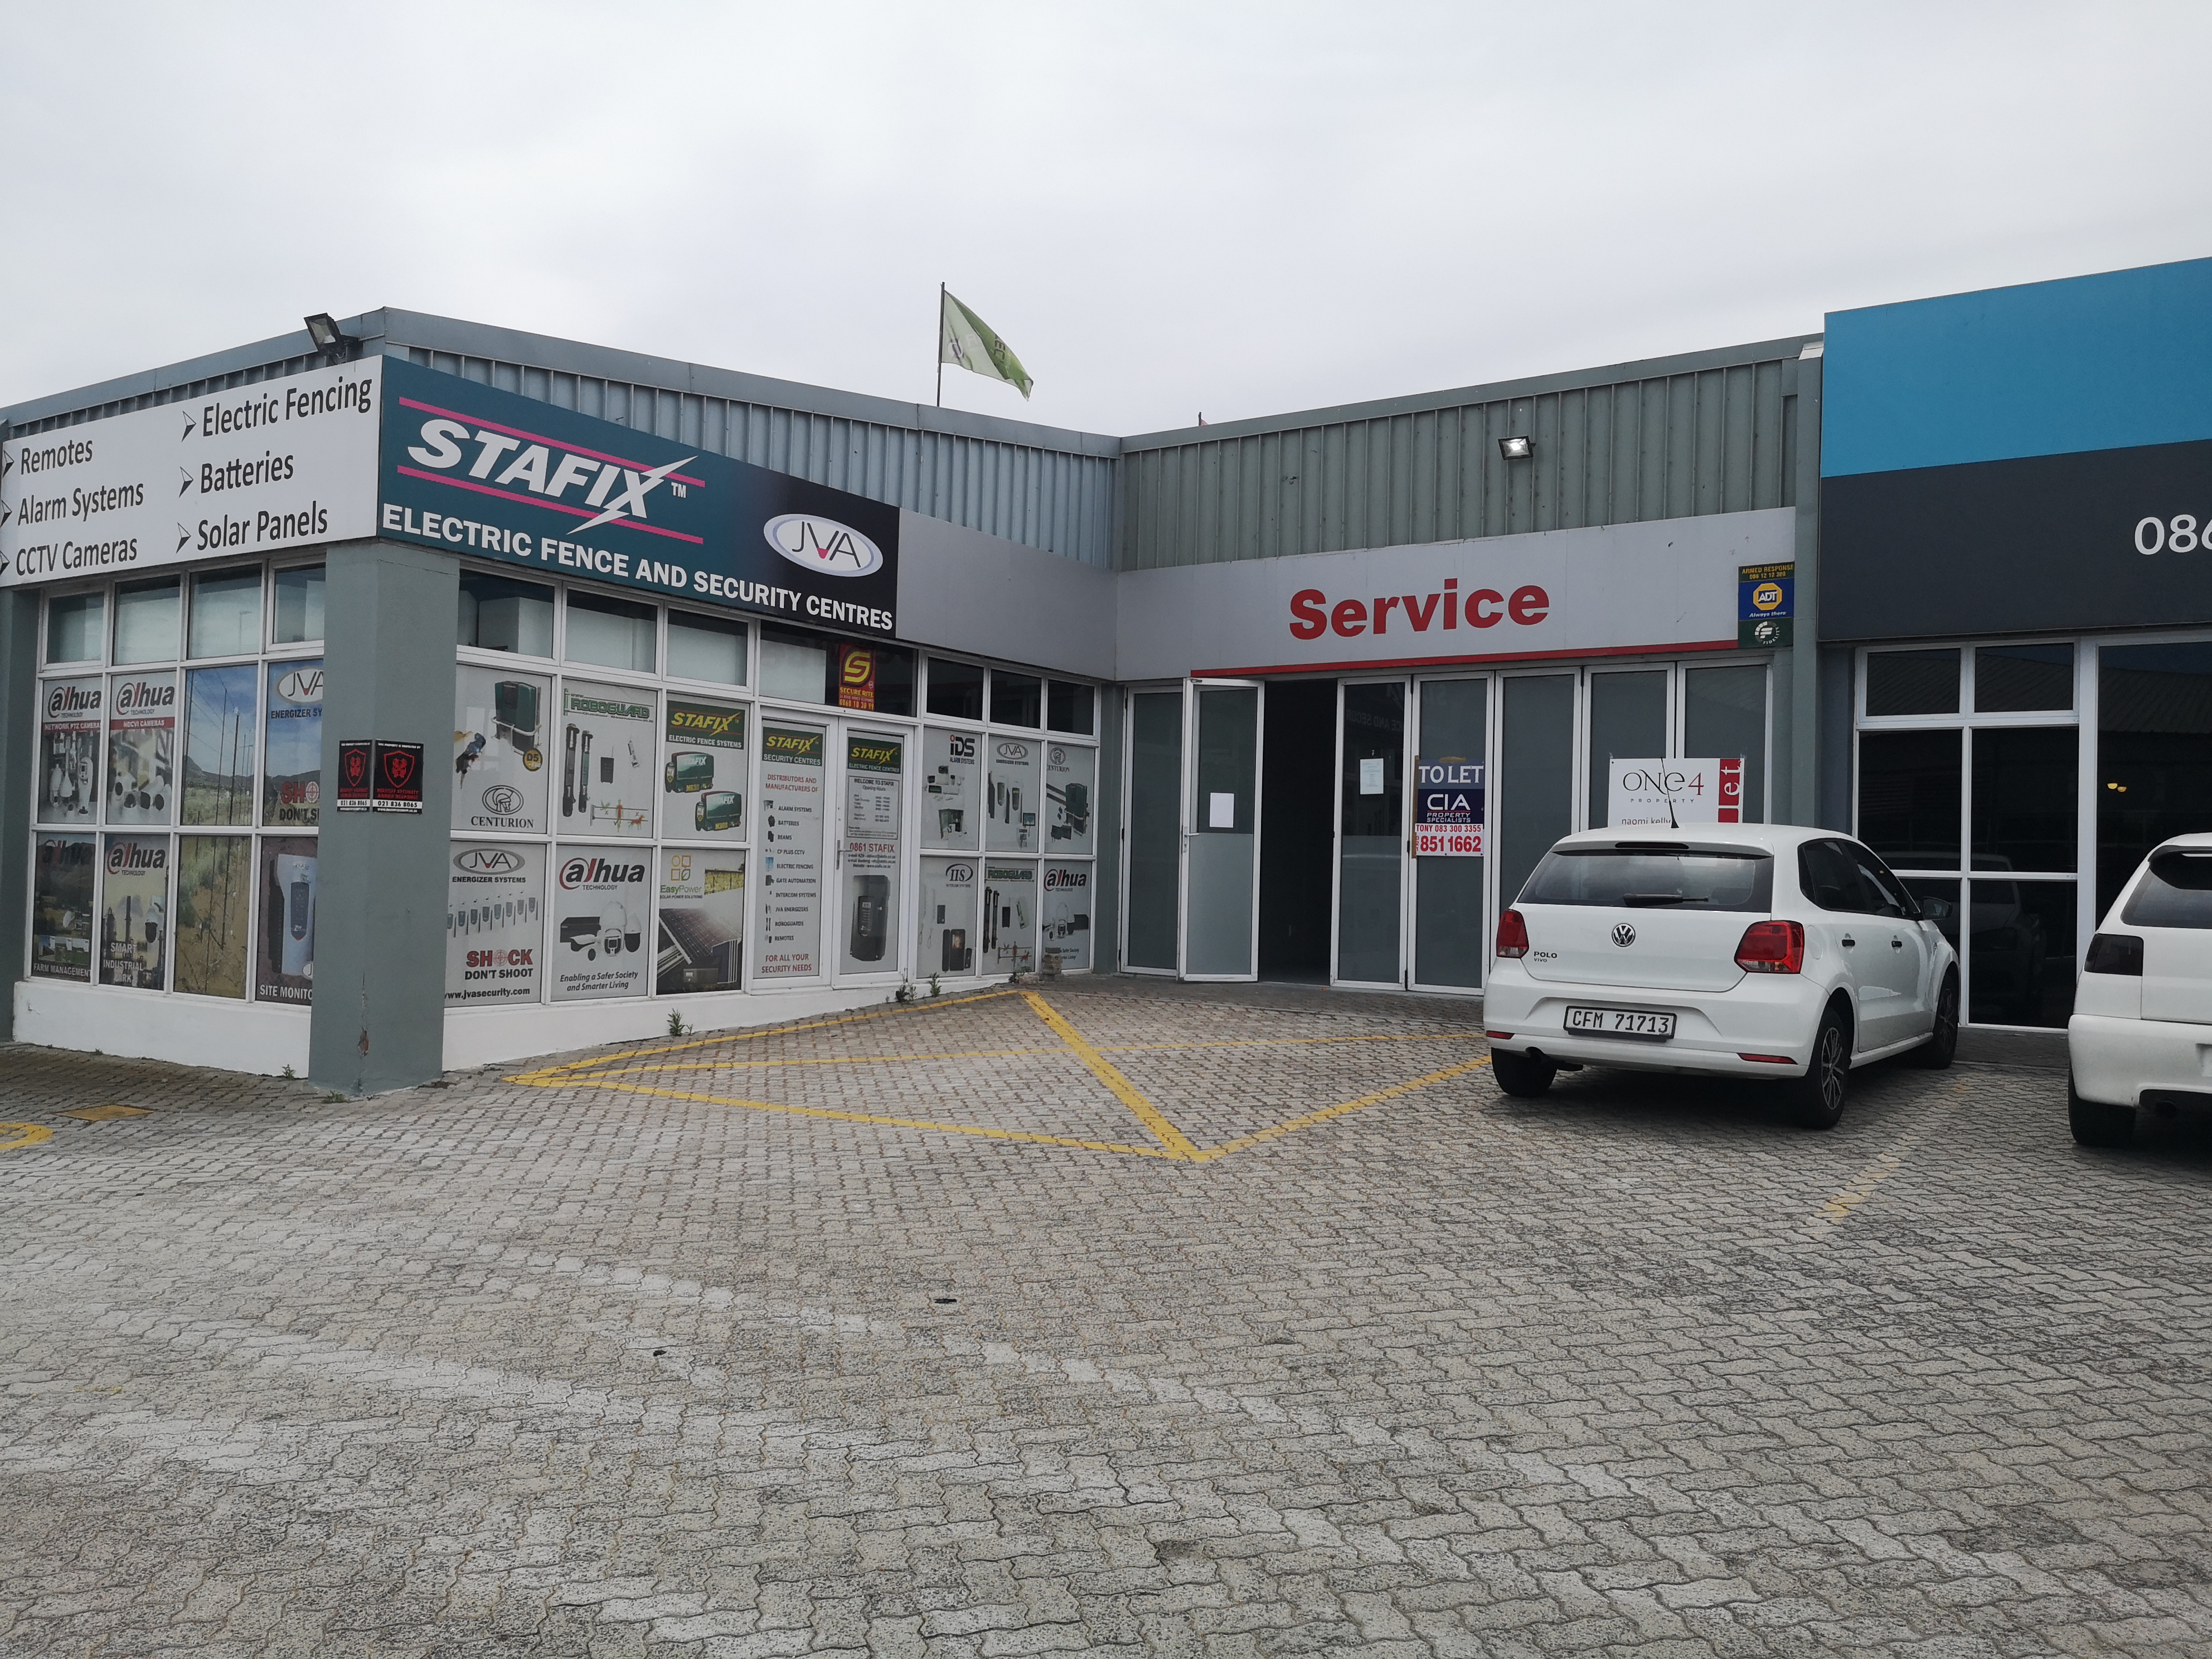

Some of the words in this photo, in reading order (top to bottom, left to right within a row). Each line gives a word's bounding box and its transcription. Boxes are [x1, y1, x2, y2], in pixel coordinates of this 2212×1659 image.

[203, 394, 278, 436] Electric
[285, 377, 372, 420] Fencing
[21, 439, 93, 475] Remotes
[201, 450, 294, 494] Batteries
[408, 419, 679, 525] STAFIX
[18, 494, 66, 526] Alarm
[72, 482, 144, 522] Systems
[197, 514, 250, 551] Solar
[256, 500, 328, 542] Panels
[792, 521, 861, 567] JVA
[16, 544, 58, 576] CCTV
[62, 537, 138, 567] Cameras
[383, 503, 532, 556] ELECTRIC
[541, 539, 629, 578] FENCE
[636, 559, 687, 588] AND
[693, 570, 802, 613] SECURITY
[807, 595, 893, 630] CENTRES
[1764, 564, 1794, 573] RESPONSE
[1758, 591, 1778, 602] ADT
[1289, 578, 1550, 641] Service
[1763, 627, 1781, 644] FIDELITY
[840, 687, 861, 696] SECURE
[271, 709, 311, 719] ENERGIZER
[571, 697, 650, 719] ROBOGUARD
[45, 722, 69, 731] NETWORK
[671, 712, 737, 735] STAFIX
[669, 735, 696, 744] ELECTRIC
[697, 737, 715, 746] FENCE
[717, 740, 742, 749] SYSTEMS
[766, 736, 814, 753] STAFIX
[851, 746, 895, 763] STAFIX
[1003, 744, 1023, 756] JVA
[527, 753, 539, 761] D5
[764, 754, 793, 763] SECURITY
[794, 756, 821, 765] CENTRES
[768, 774, 804, 783] DISTRIBUTORS
[1418, 765, 1444, 784] TO
[1448, 765, 1484, 784] LET
[765, 783, 811, 793] MANUFACTURERS
[1427, 794, 1471, 811] CIA
[470, 816, 533, 828] CENTURION
[850, 842, 866, 852] 0861
[869, 843, 895, 853] STAFIX
[1420, 836, 1444, 852] 851
[1447, 836, 1481, 852] 1662
[469, 852, 512, 869] JVA
[660, 885, 702, 895] EasyPower
[111, 942, 137, 953] SMART
[33, 963, 50, 972] FARM
[103, 959, 144, 971] INDUSTRIAL
[761, 965, 791, 973] SECURITY
[465, 970, 497, 980] DON'T
[499, 968, 533, 978] SHOOT
[560, 973, 590, 983] Enabling
[615, 971, 639, 980] Society
[260, 985, 278, 997] SITE
[581, 982, 608, 991] Smarter
[609, 982, 629, 990] Living
[1573, 1010, 1604, 1029] CFM
[1614, 1013, 1670, 1034] 71713
